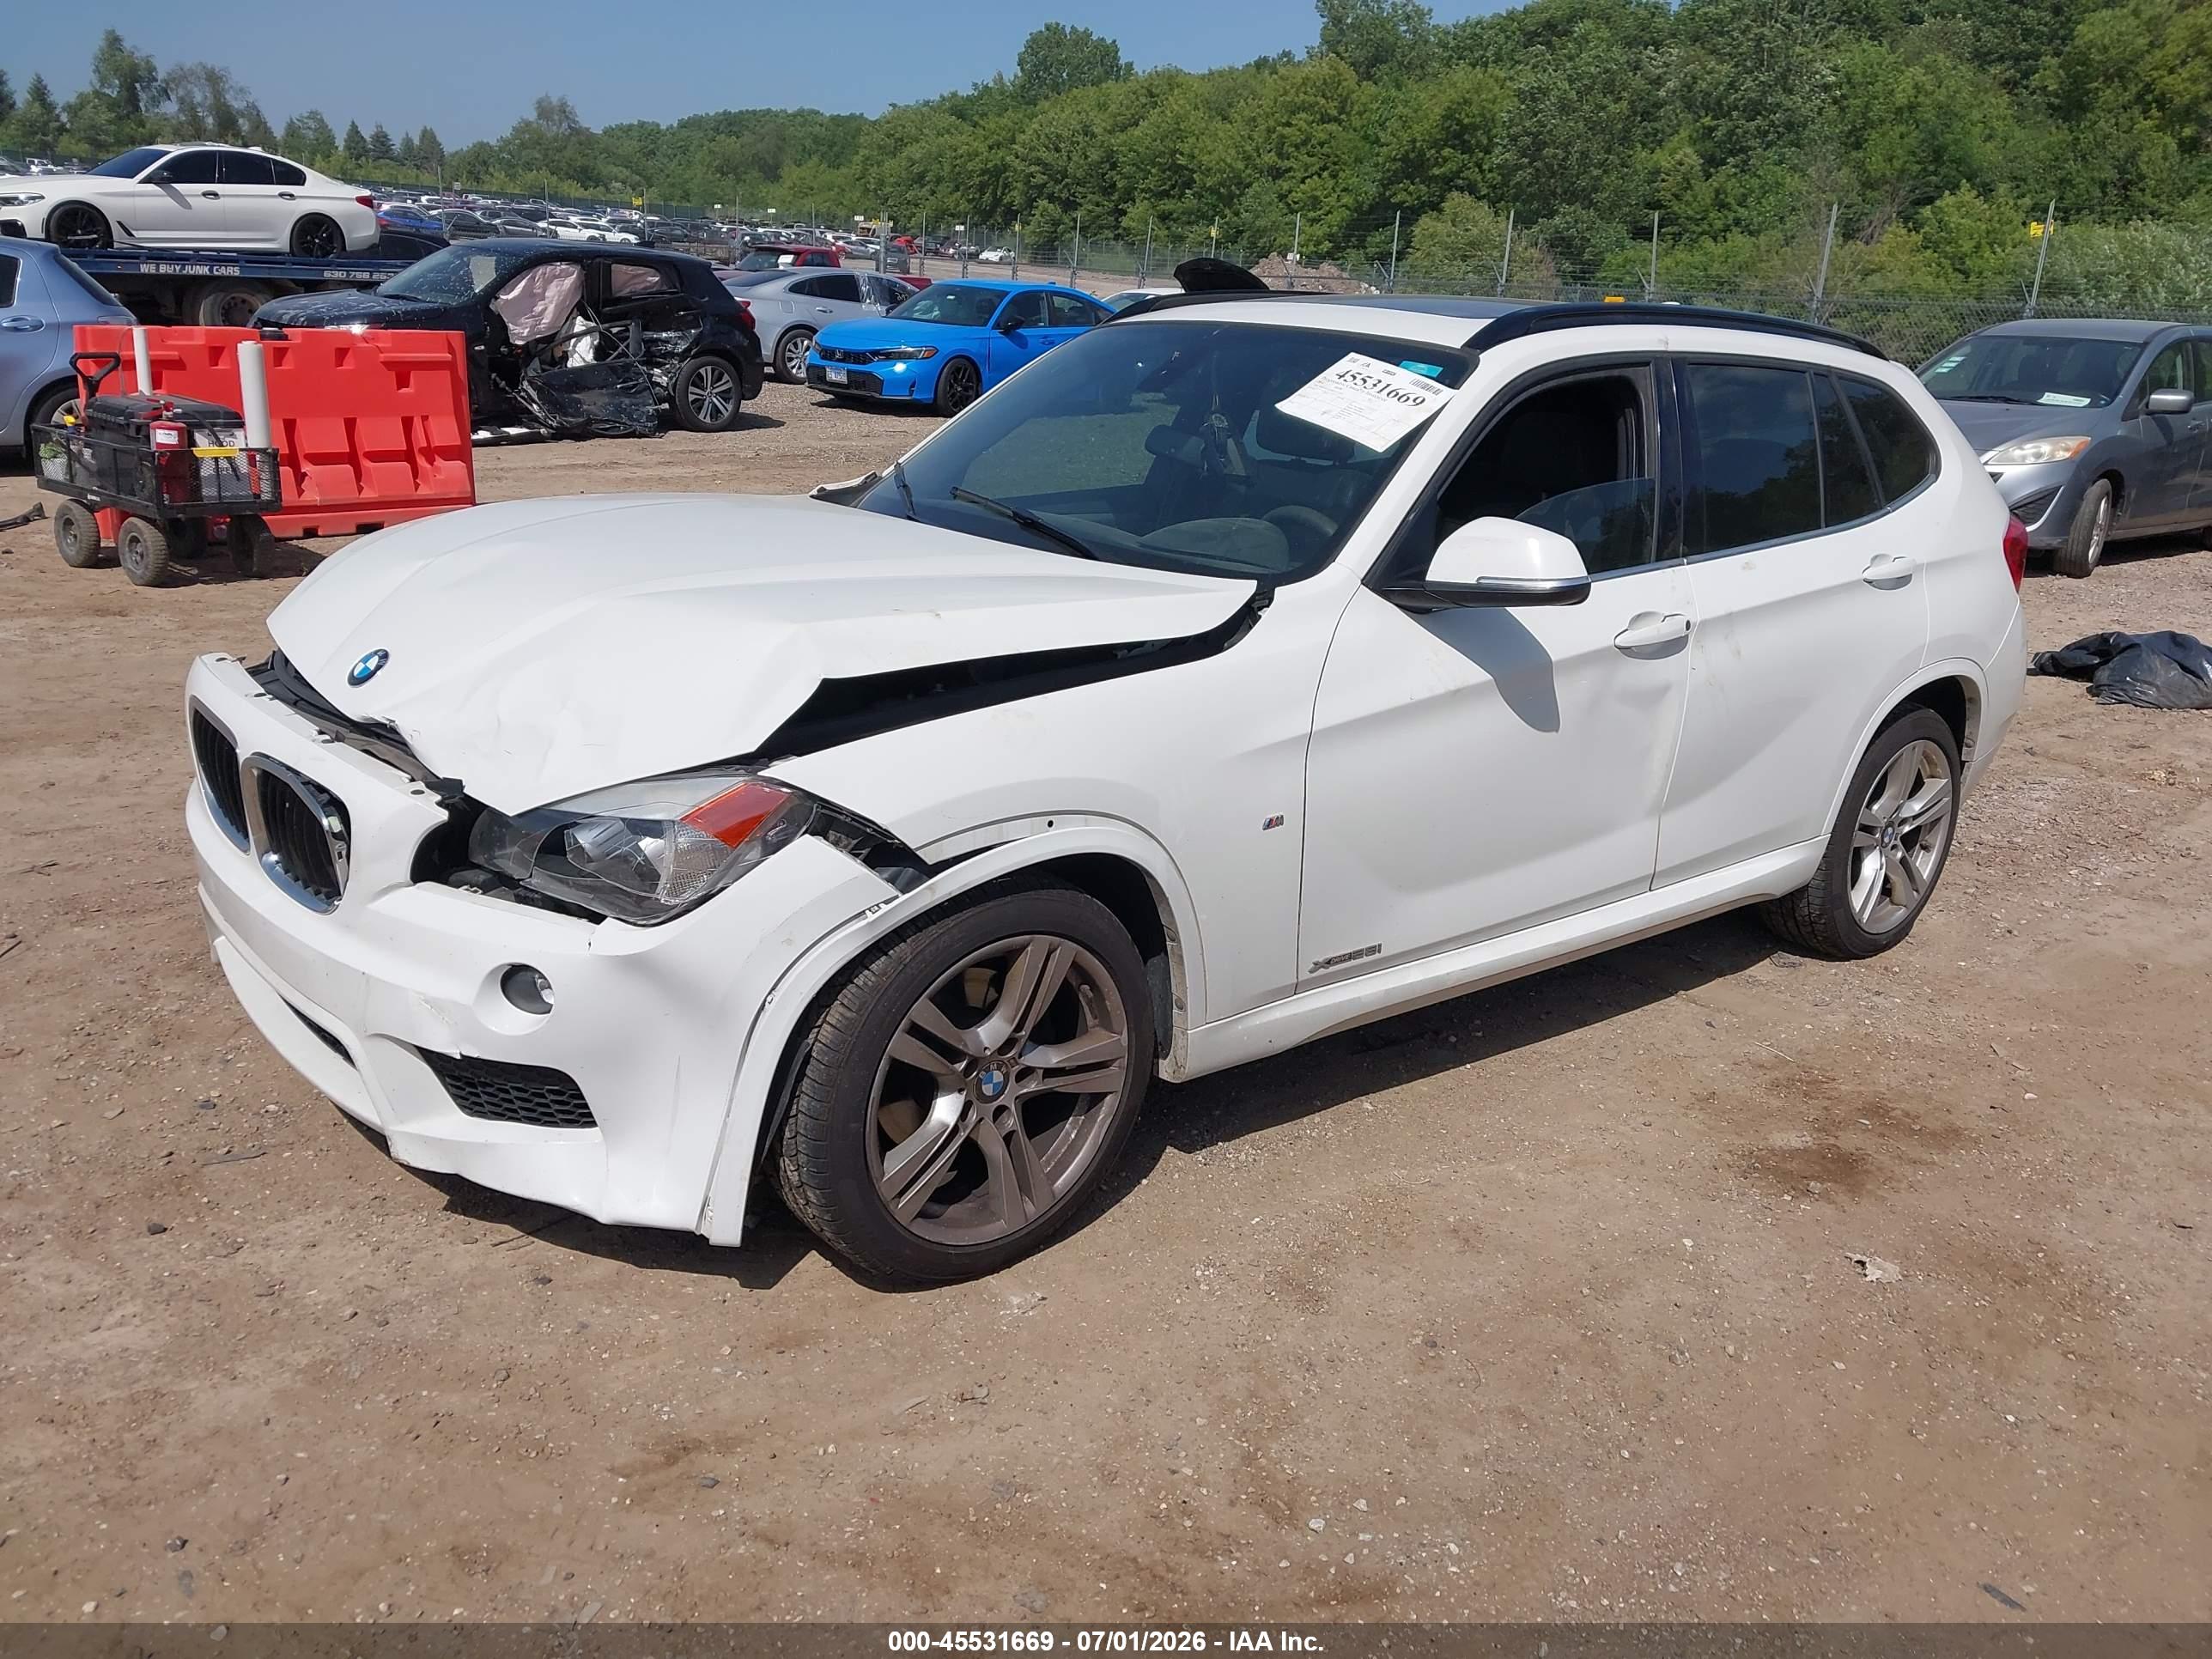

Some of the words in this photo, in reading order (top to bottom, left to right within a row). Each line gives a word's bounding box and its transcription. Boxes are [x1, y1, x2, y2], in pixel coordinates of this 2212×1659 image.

[139, 263, 156, 273] WE
[159, 264, 182, 273] BUY
[182, 264, 210, 275] JUNK
[213, 265, 240, 276] CARS
[323, 270, 346, 278] 630
[1334, 368, 1426, 408] 45531669
